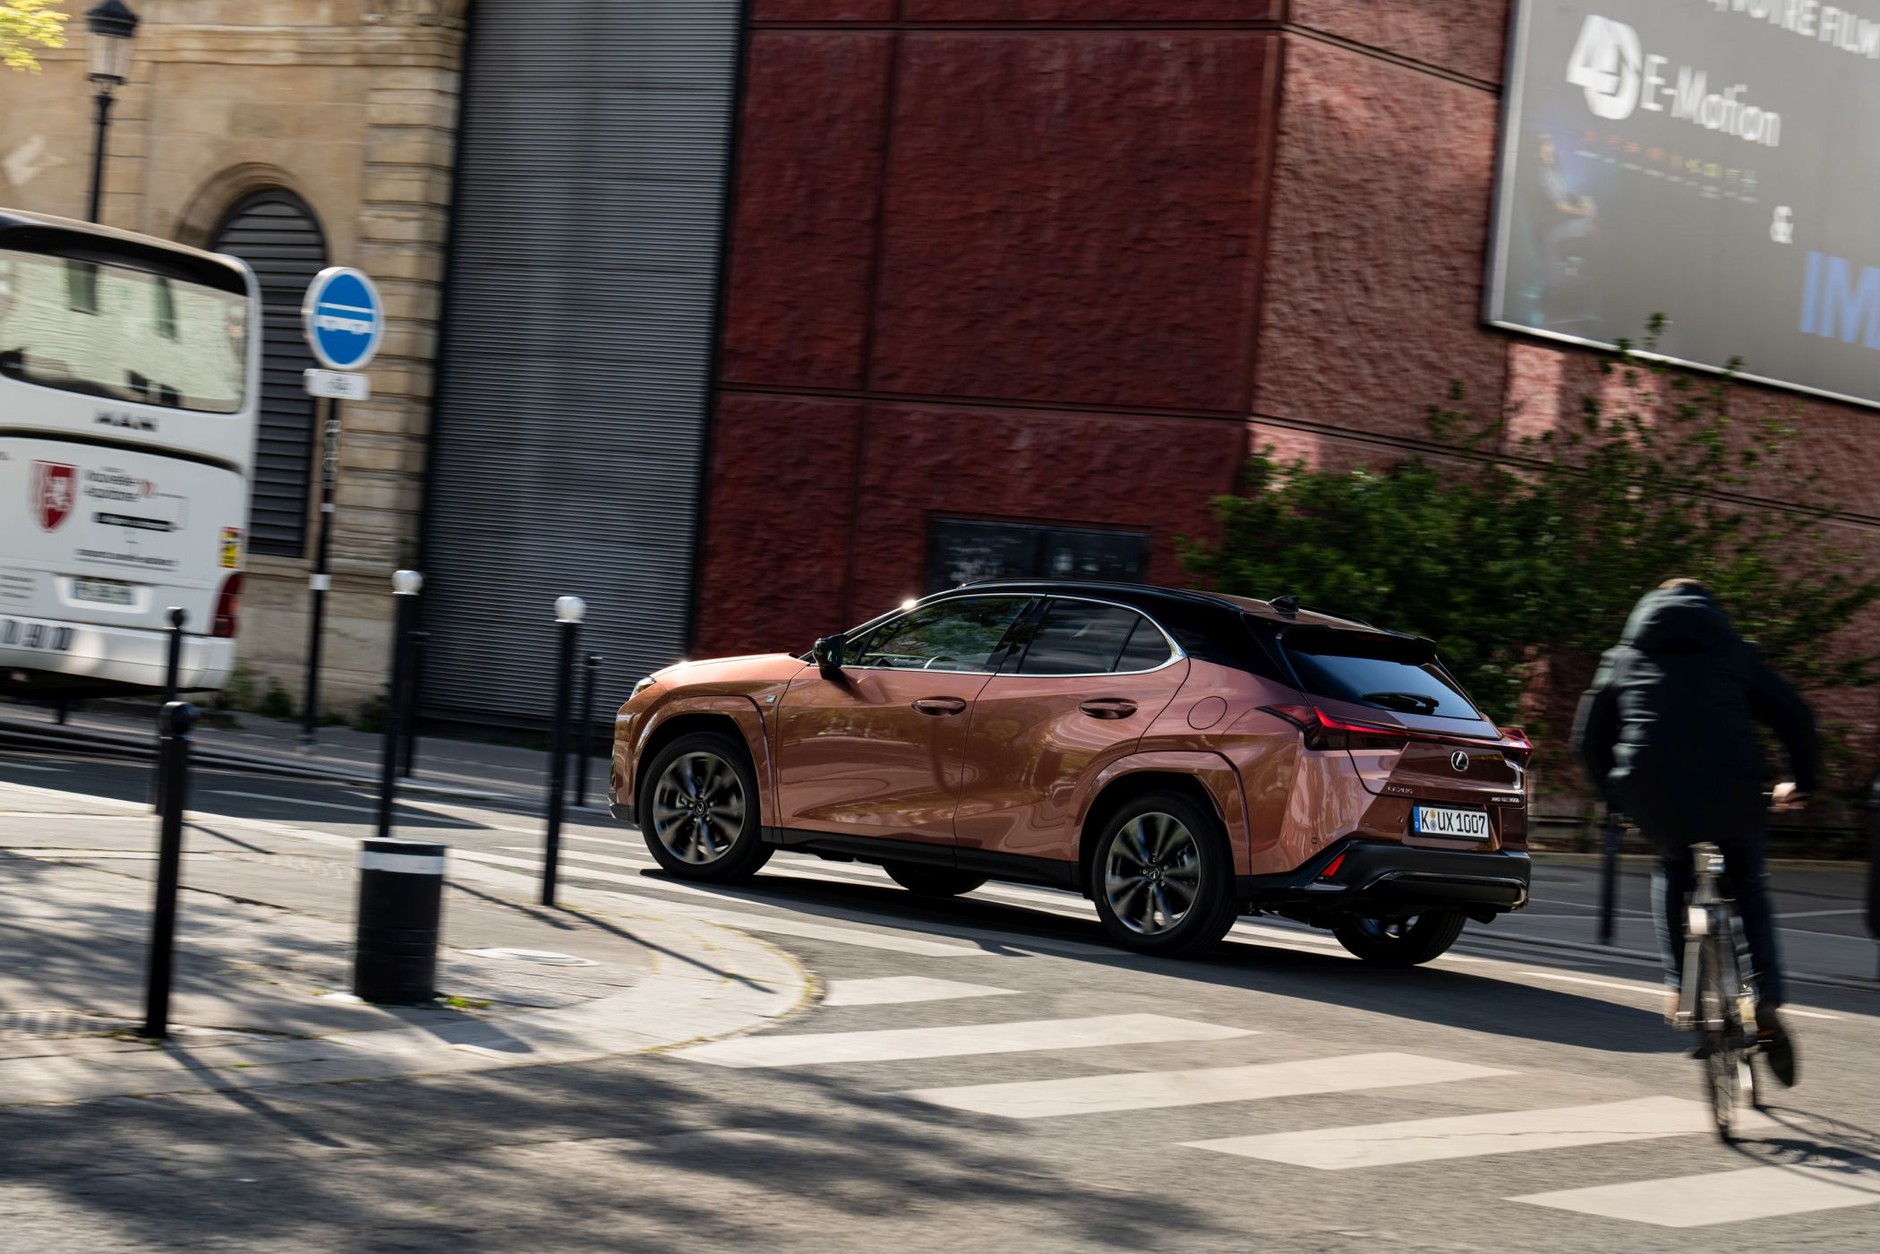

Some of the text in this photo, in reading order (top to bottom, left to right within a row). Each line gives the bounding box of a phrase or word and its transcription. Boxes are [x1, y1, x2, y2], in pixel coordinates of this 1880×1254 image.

[1566, 14, 1782, 147] 4D E-Motion
[1455, 813, 1486, 835] 1007
